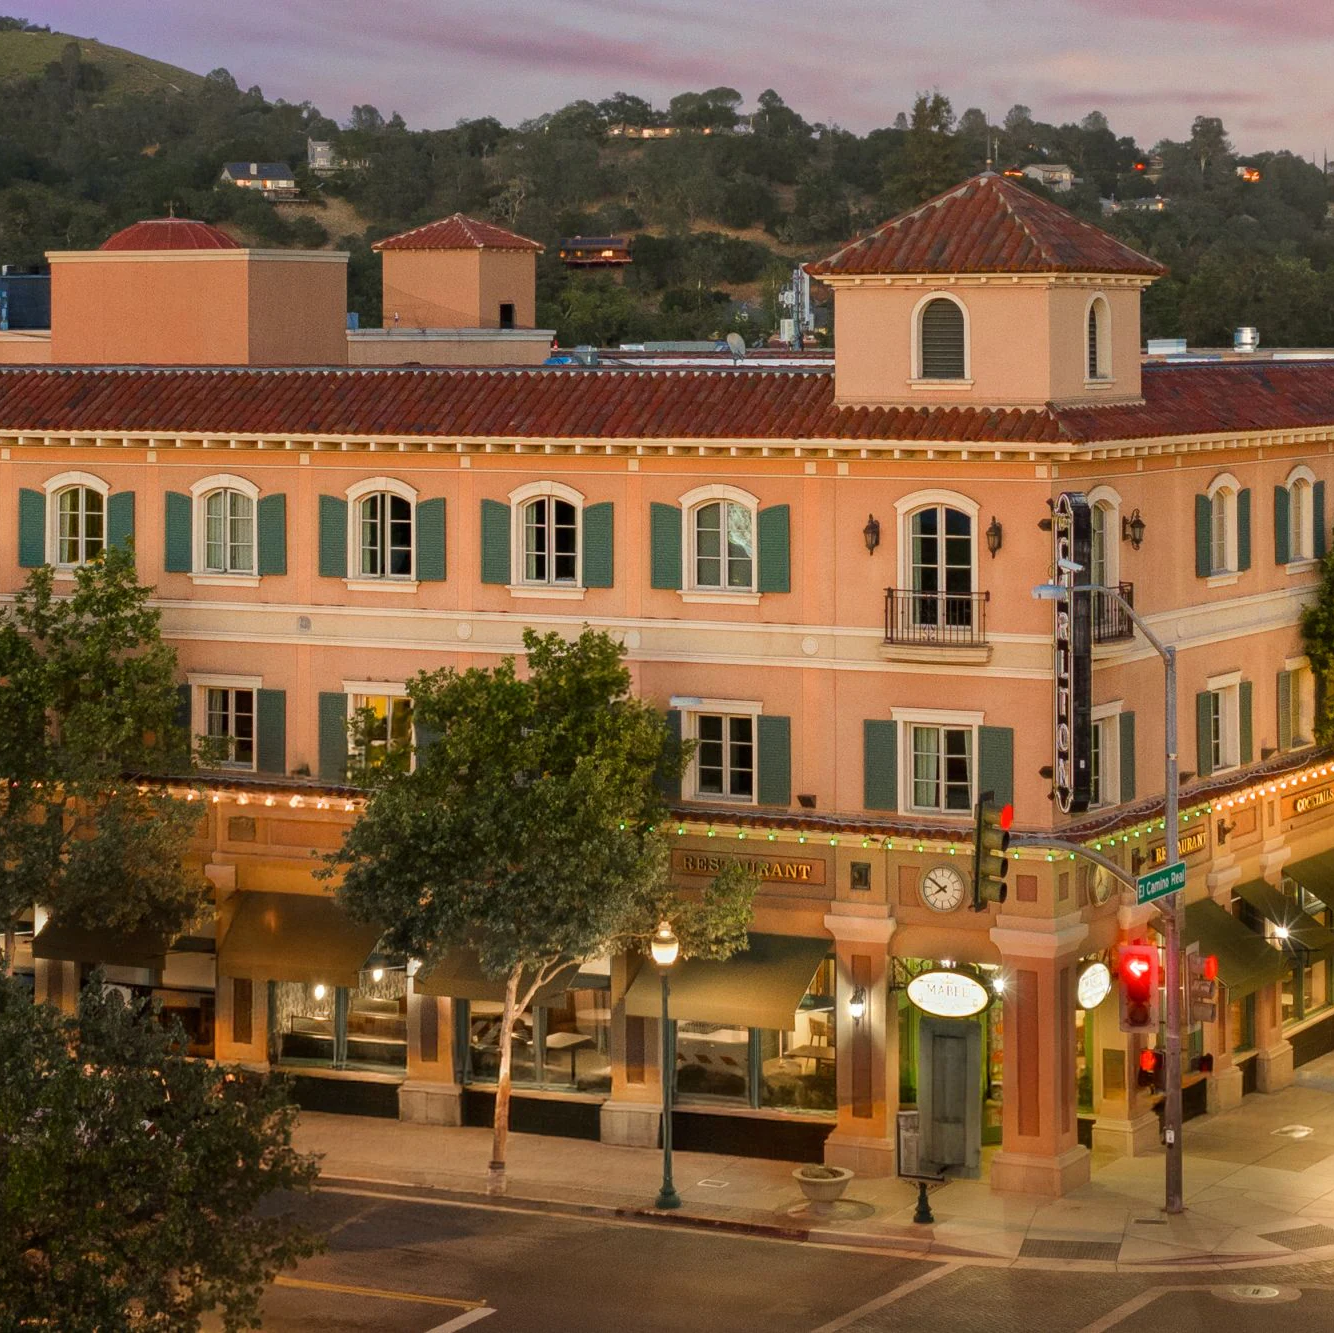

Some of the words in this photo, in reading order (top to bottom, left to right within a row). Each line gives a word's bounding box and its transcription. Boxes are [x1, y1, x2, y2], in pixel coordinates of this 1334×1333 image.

[1297, 789, 1334, 812] COCKTAILS
[1156, 832, 1207, 864] REAURANT
[1138, 884, 1145, 899] El
[1146, 876, 1170, 895] Camino
[1170, 868, 1185, 886] Real
